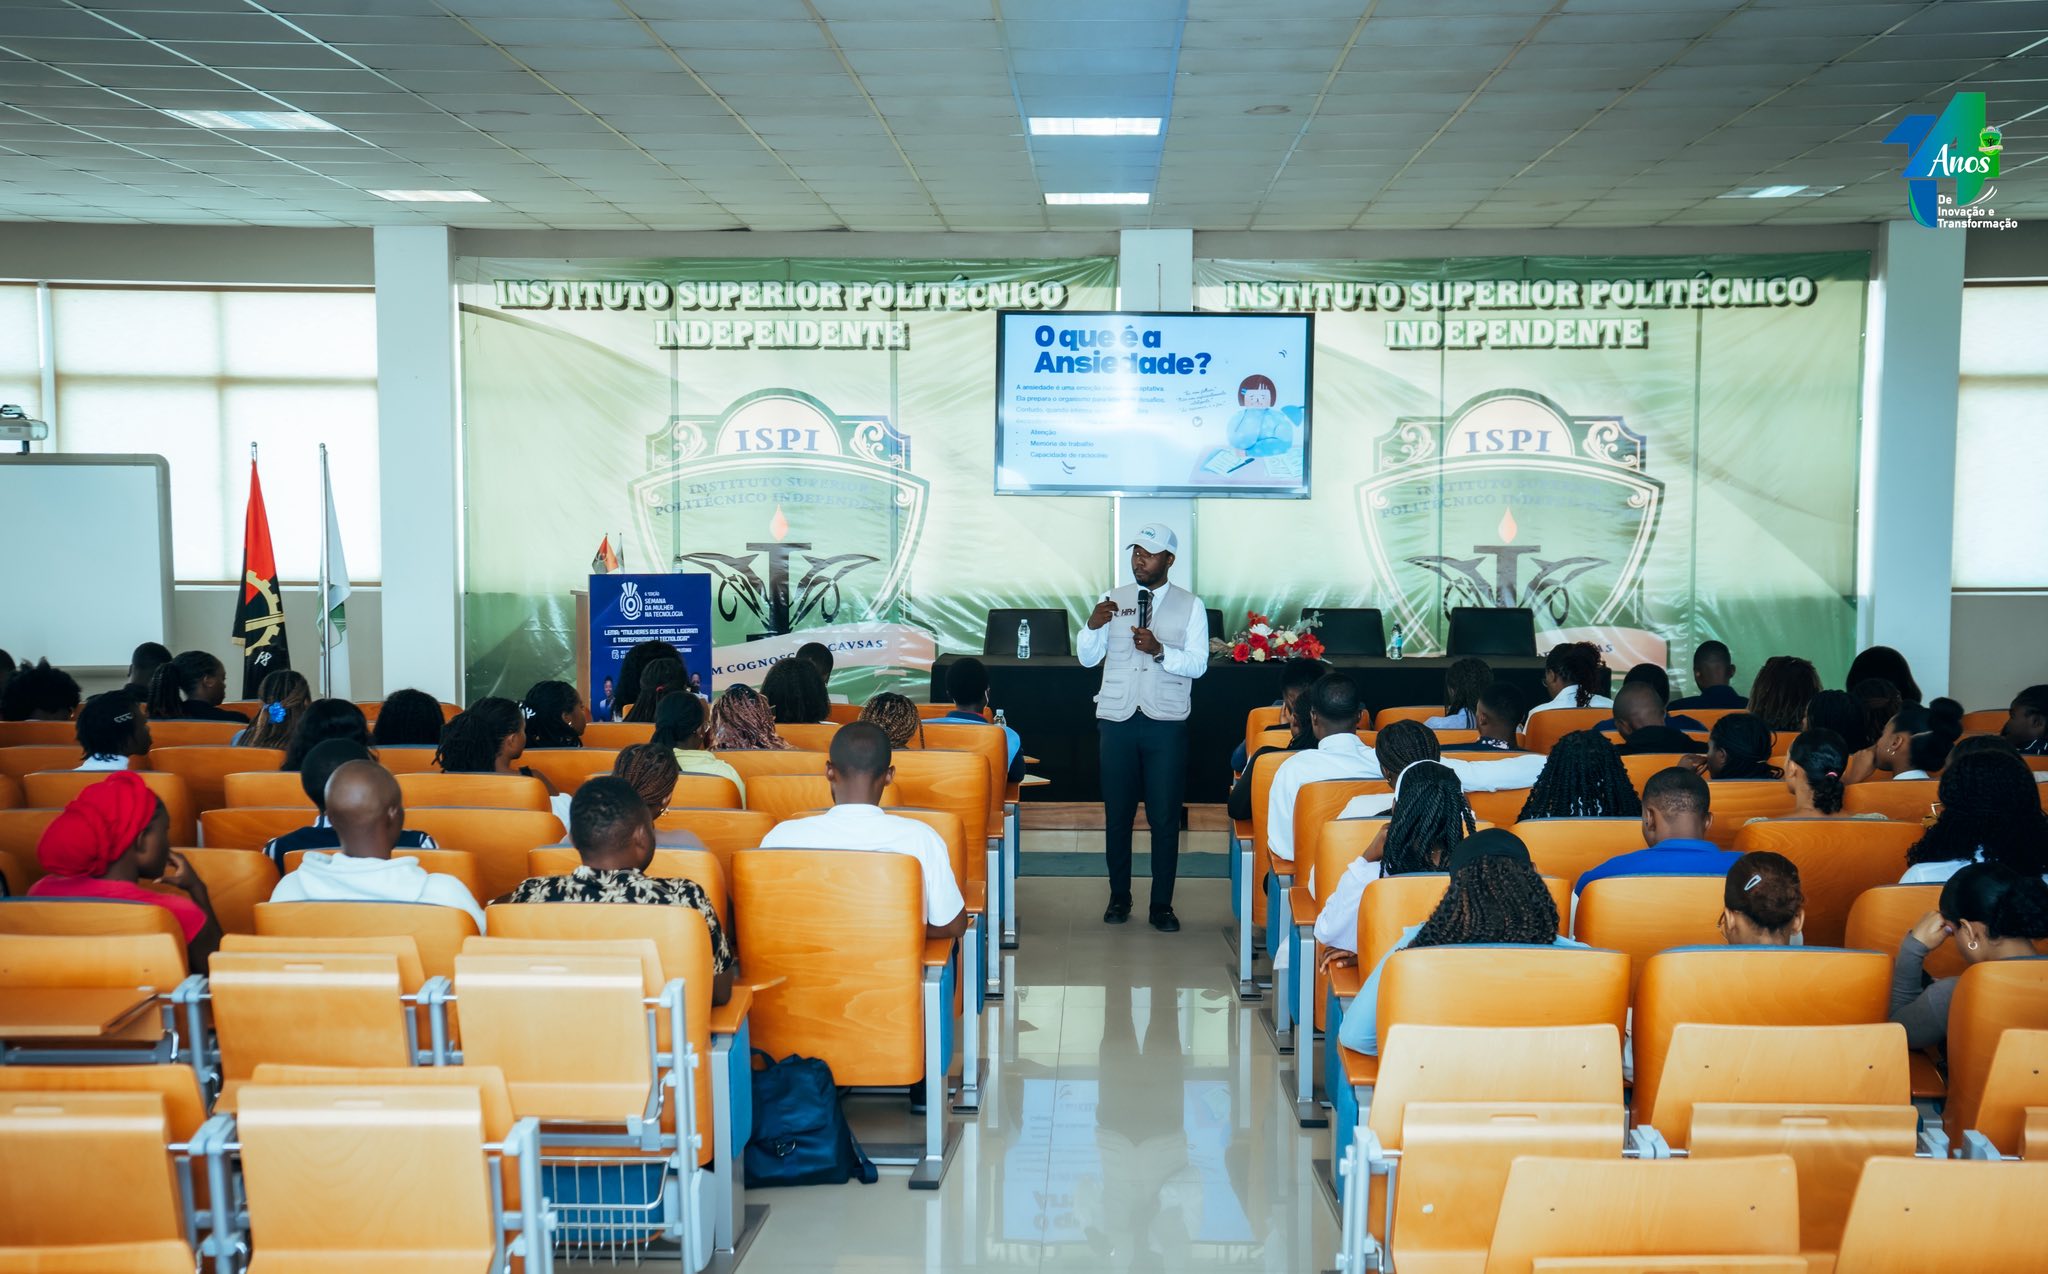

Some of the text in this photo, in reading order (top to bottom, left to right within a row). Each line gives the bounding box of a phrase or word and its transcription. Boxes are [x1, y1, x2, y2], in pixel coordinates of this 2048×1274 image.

[494, 273, 1069, 312] INSTITUTO SUPERIOR POLITÉCNICO
[1225, 270, 1818, 312] INSTITUTO SUPERIOR POLITÉCNICO
[654, 319, 910, 351] INDEPENDENTE
[1034, 325, 1162, 351] O que é a
[1385, 318, 1649, 351] INDEPENDENTE
[1033, 350, 1212, 375] Ansiedade?
[735, 428, 820, 452] ISPI
[1465, 429, 1553, 453] ISPI
[1030, 451, 1067, 459] Capacidade
[689, 477, 784, 495] INSTITUTO
[1416, 478, 1513, 496] INSTITUTO
[655, 492, 768, 516] POLITÉCNICO
[827, 639, 884, 652] CAVSAS
